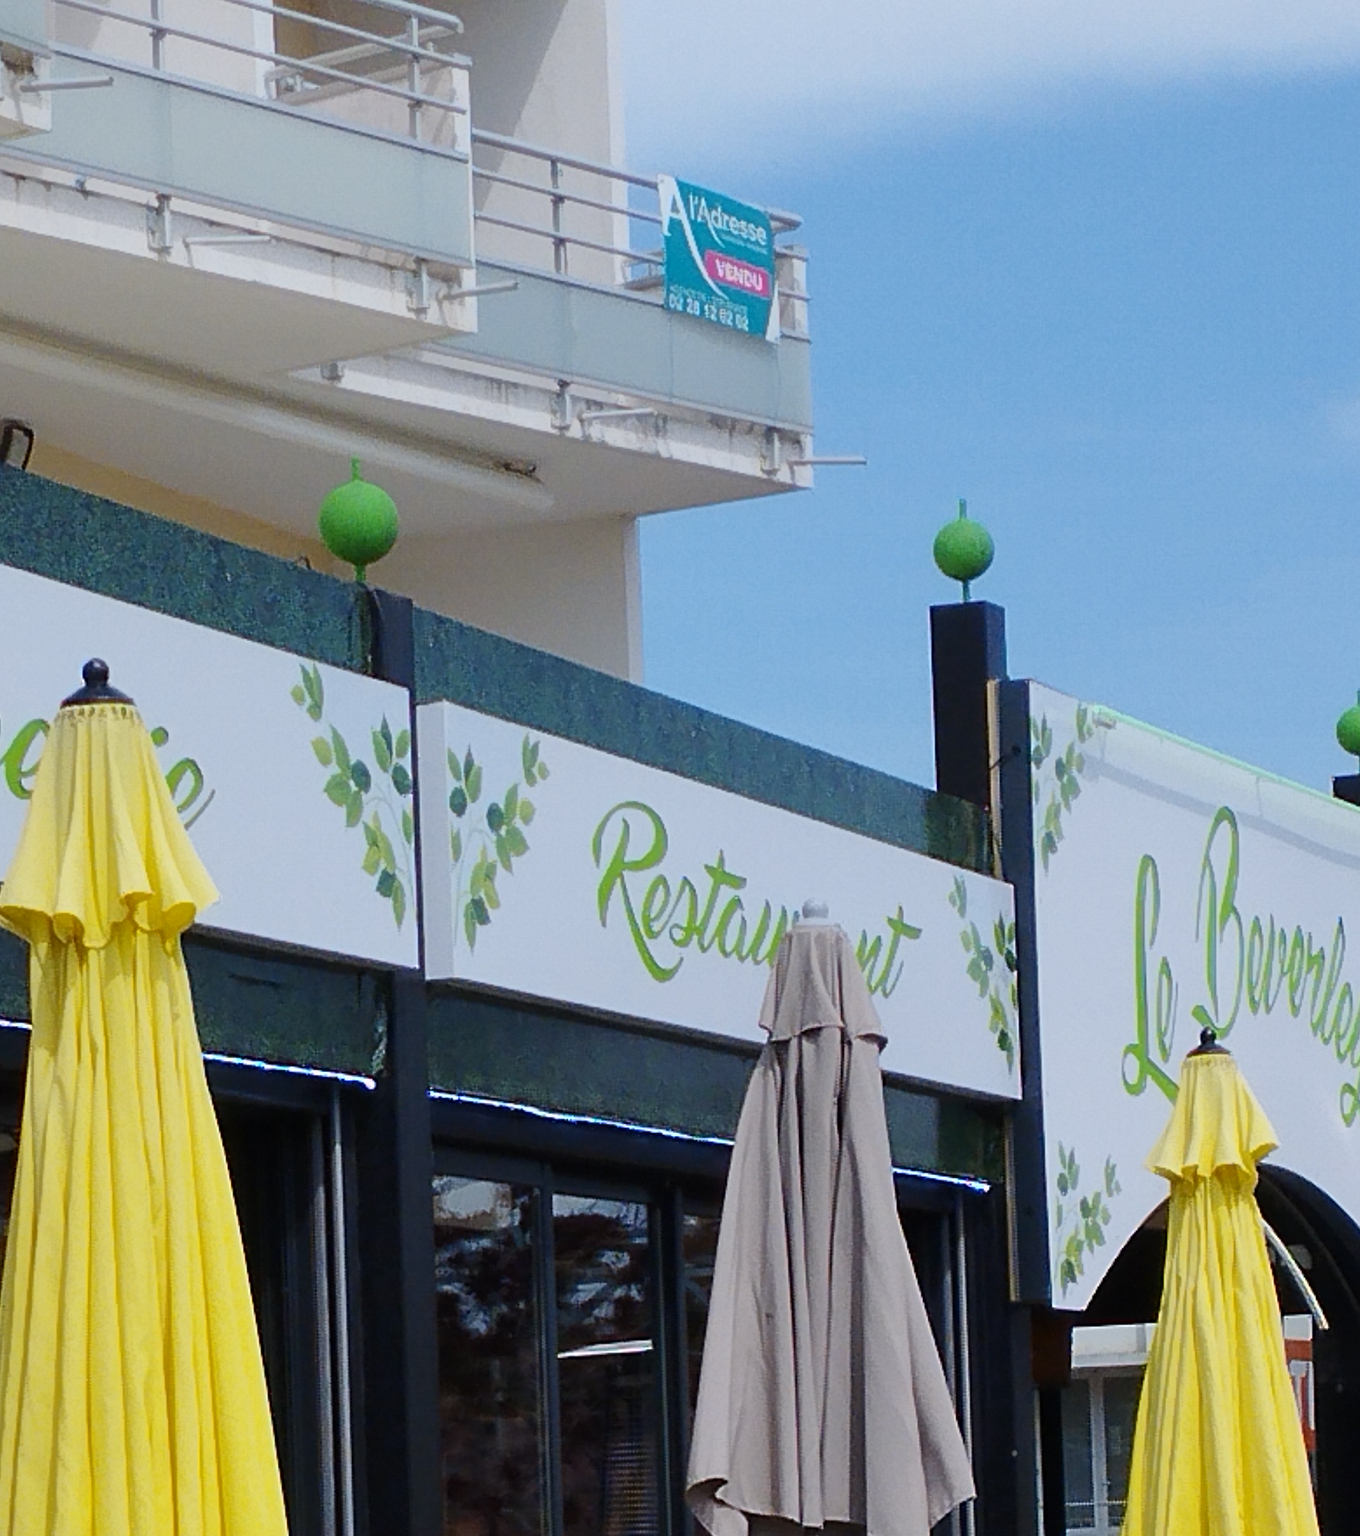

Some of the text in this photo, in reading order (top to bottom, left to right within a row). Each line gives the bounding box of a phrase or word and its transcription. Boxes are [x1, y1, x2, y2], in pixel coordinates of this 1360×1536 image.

[689, 192, 768, 248] l'Adresse
[715, 258, 763, 292] VENDU
[592, 801, 923, 998] Restaunt
[1121, 854, 1180, 1106] Le
